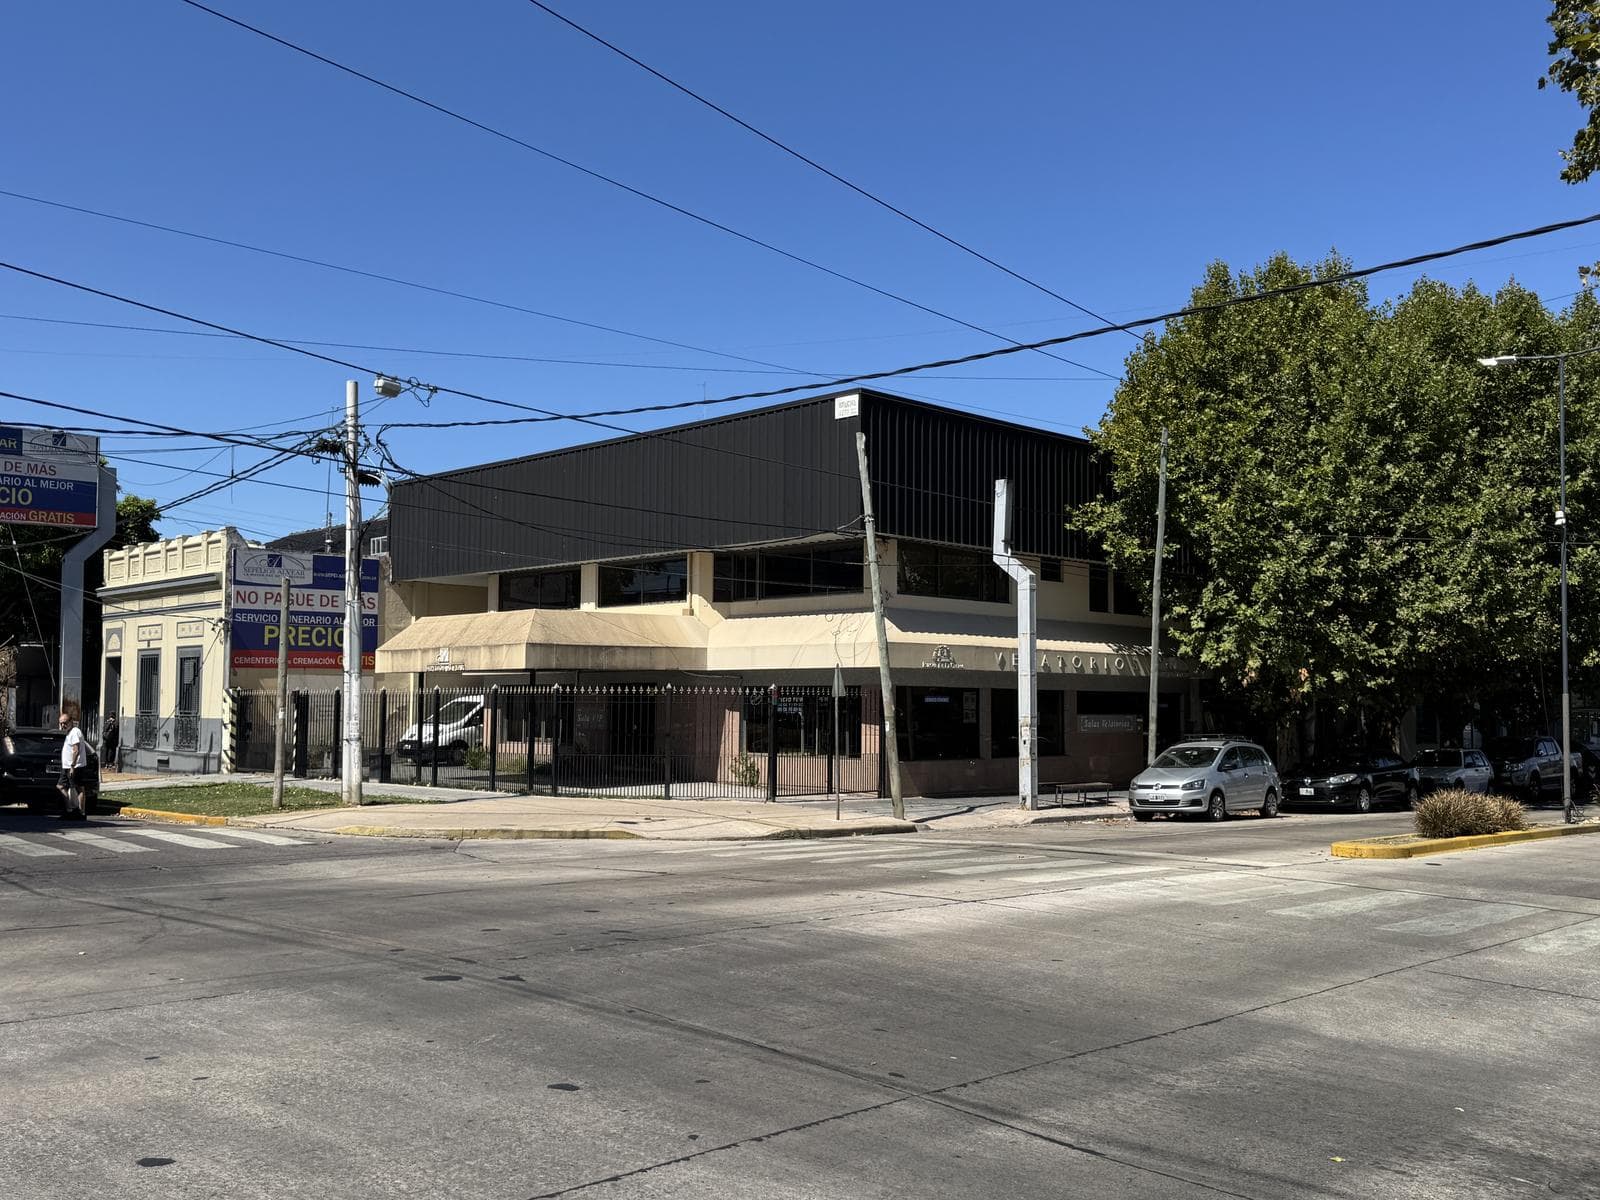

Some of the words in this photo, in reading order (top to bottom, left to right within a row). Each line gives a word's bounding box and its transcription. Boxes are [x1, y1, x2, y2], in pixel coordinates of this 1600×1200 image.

[4, 460, 22, 473] DE
[27, 462, 57, 476] MÁS
[24, 478, 37, 488] AL
[40, 479, 74, 491] MEJOR
[29, 510, 75, 524] GRATIS
[236, 590, 258, 604] NO
[320, 594, 339, 607] DE
[235, 613, 278, 623] SERVICIO
[234, 656, 279, 665] CEMENTERI
[292, 656, 335, 665] CREMACIÓN
[994, 651, 1125, 670] VEATORIO
